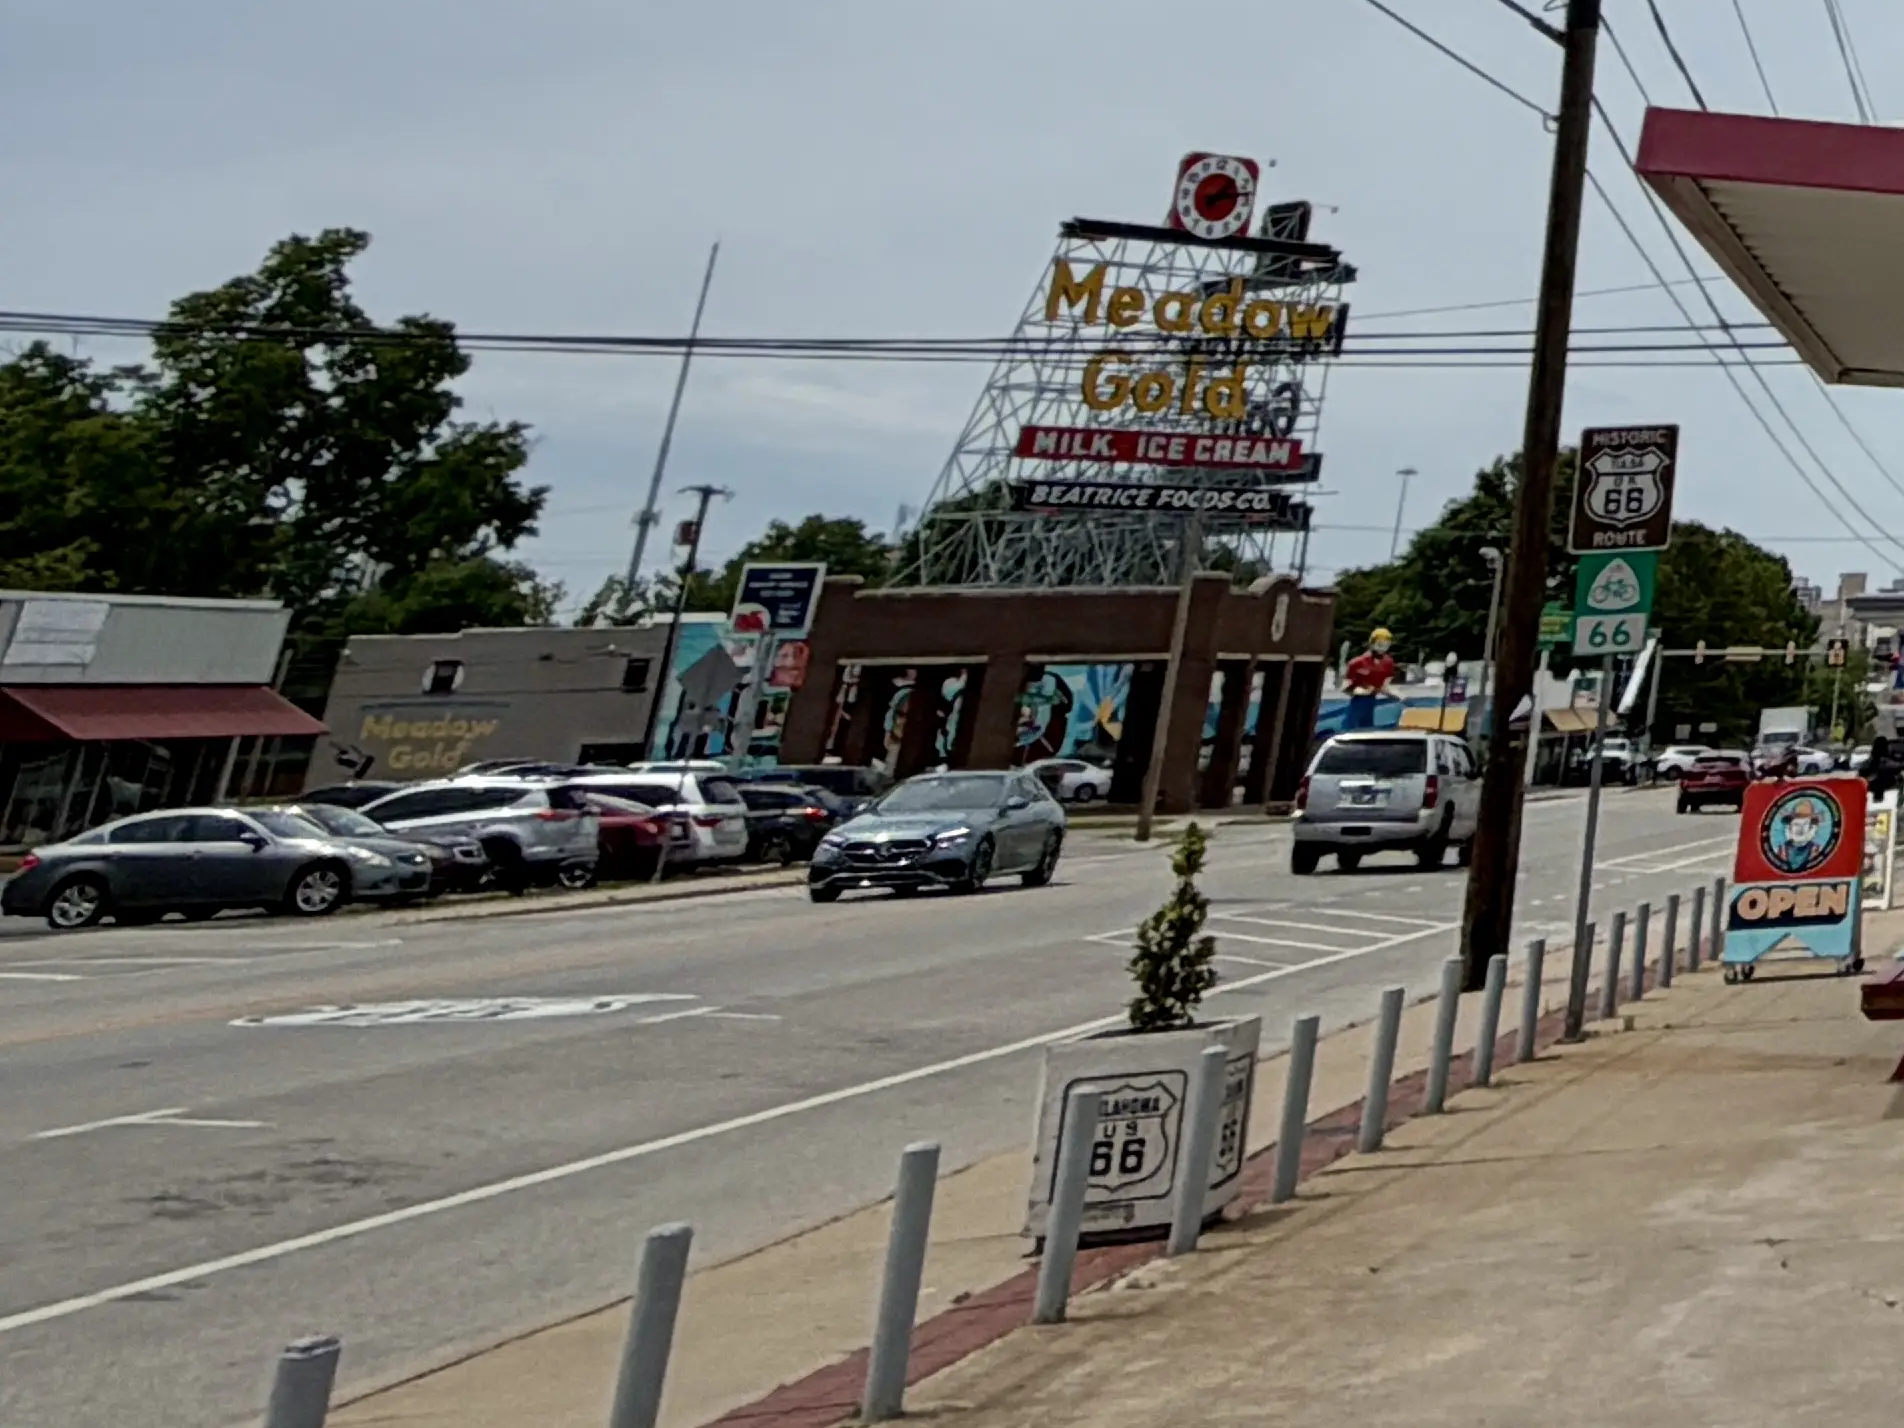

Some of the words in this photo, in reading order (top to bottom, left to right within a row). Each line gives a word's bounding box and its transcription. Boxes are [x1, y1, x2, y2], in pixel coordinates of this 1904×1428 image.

[1045, 257, 1333, 339] Meadow
[1081, 350, 1250, 421] Gold
[1136, 434, 1187, 460] ICE
[1193, 439, 1290, 465] CREAM
[1592, 429, 1668, 446] HISTORIC
[1030, 484, 1155, 508] BEATRICE
[1604, 487, 1644, 514] 66
[1593, 529, 1648, 547] ROUTE
[1588, 620, 1630, 648] 66
[360, 711, 498, 741] Meadow
[388, 741, 472, 770] Gold
[1736, 884, 1848, 921] OPEN
[1089, 1138, 1146, 1176] 66
